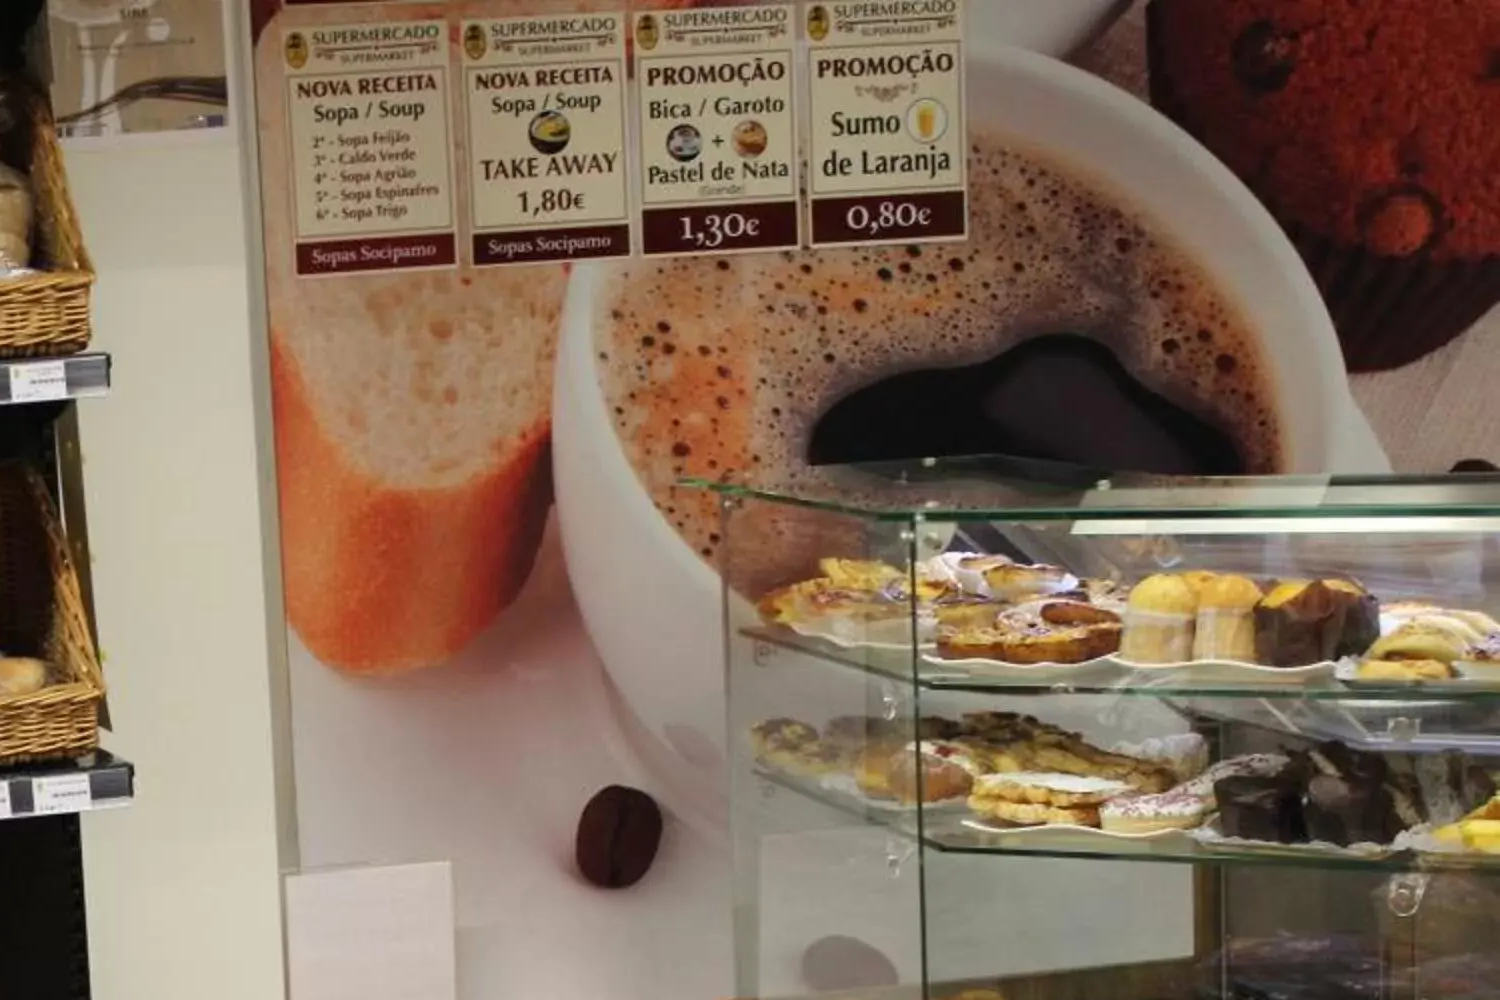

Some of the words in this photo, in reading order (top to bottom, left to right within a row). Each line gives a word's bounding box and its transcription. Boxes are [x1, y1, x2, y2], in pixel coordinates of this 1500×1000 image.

[664, 8, 787, 28] SUPERMERCADO
[833, 0, 956, 18] SUPERMERCADO
[312, 25, 439, 44] SUPERMERCADO
[491, 18, 616, 37] SUPERMERCADO
[647, 57, 785, 87] PROMOÇÃO
[817, 49, 953, 78] PROMOÇÃO
[297, 79, 352, 99] NOVA
[358, 74, 437, 95] RECEITA
[475, 71, 529, 91] NOVA
[535, 66, 613, 87] RECEITA
[314, 105, 358, 126] Sopa
[365, 102, 373, 118] /
[379, 100, 425, 121] Soup
[492, 97, 535, 117] Sopa
[542, 94, 549, 110] /
[555, 92, 601, 113] Soup
[649, 99, 691, 119] Bica
[699, 98, 707, 116] /
[714, 96, 784, 116] Garoto
[831, 112, 900, 137] Sumo
[337, 134, 369, 149] Sopa
[339, 152, 376, 165] Caldo
[379, 149, 416, 161] Verde
[479, 157, 539, 181] TAKE
[545, 151, 618, 176] AWAY
[823, 150, 852, 176] de
[862, 146, 950, 179] Laranja
[339, 170, 370, 184] Sopa
[648, 162, 703, 185] Pastel
[711, 161, 735, 181] de
[742, 160, 789, 179] Nata
[340, 188, 371, 203] Sopa
[517, 188, 585, 217] 1,80€
[341, 206, 373, 222] Sopa
[376, 204, 408, 219] Trigo
[312, 248, 357, 267] Sopas
[360, 244, 437, 264] Socipamo
[488, 238, 533, 259] Sopas
[535, 235, 611, 255] Socipamo
